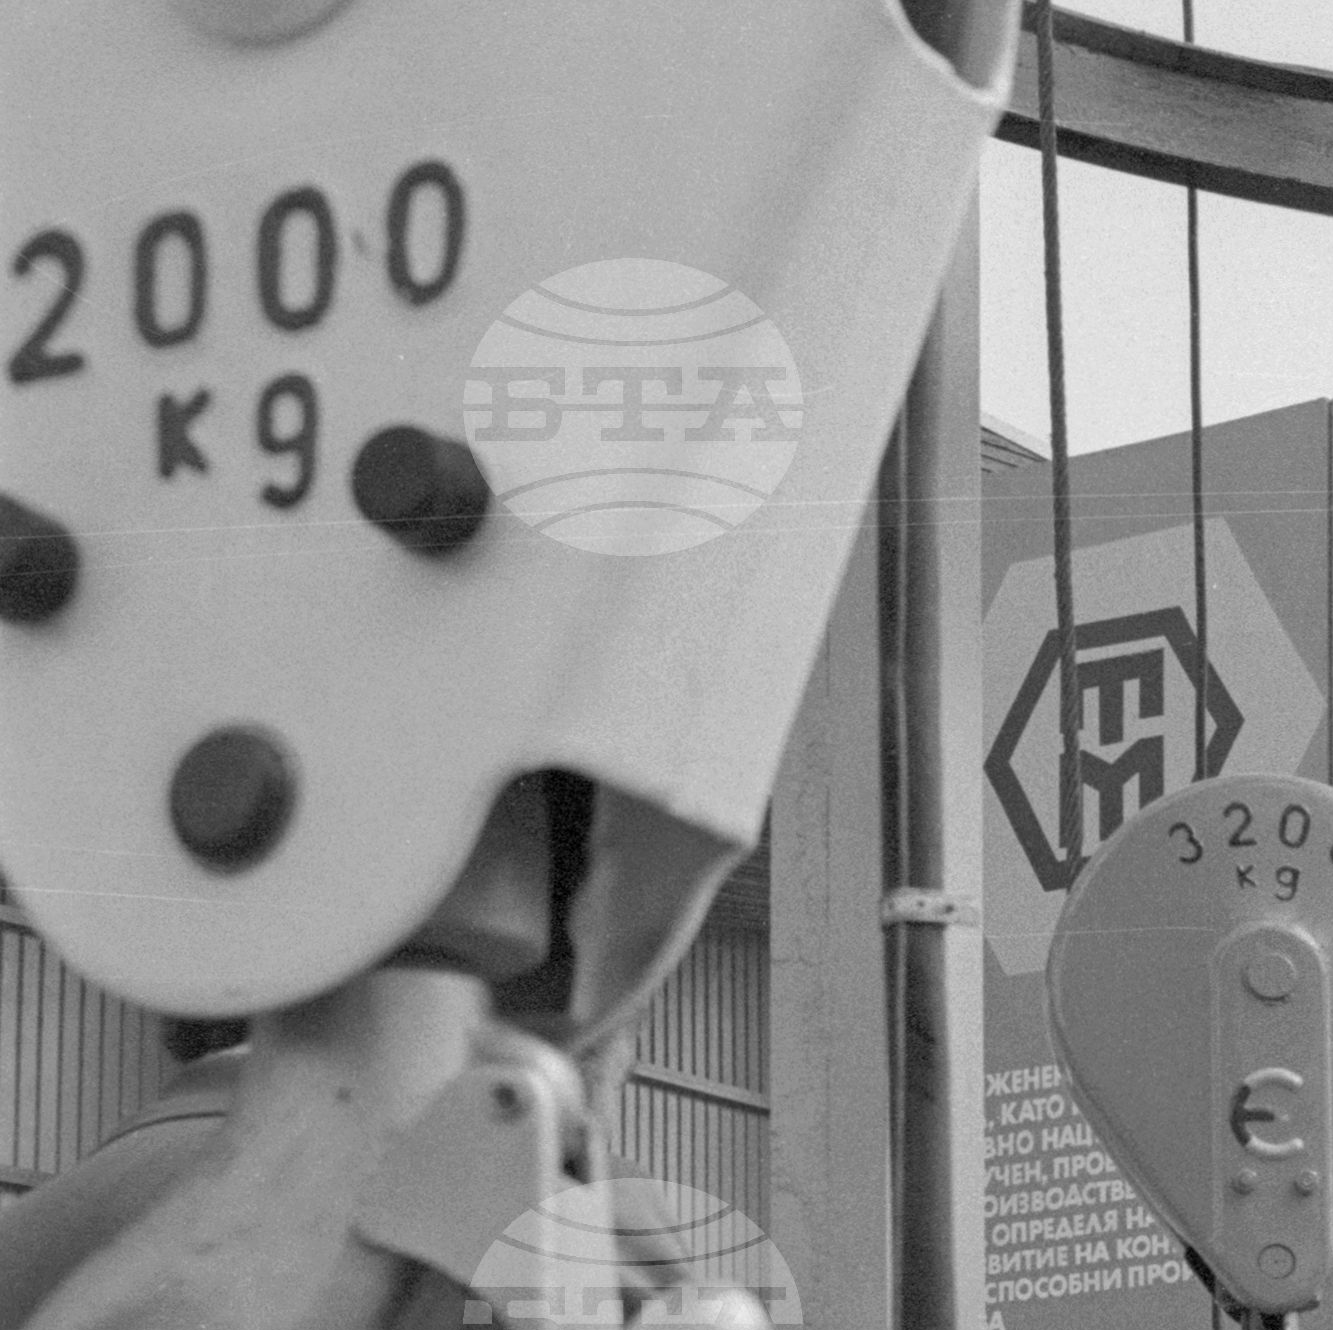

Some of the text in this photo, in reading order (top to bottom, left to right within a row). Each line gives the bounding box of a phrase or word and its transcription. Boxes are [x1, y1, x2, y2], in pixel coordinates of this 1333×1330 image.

[7, 158, 468, 385] 2000
[156, 371, 321, 510] kg
[1235, 864, 1300, 901] kg
[1000, 1094, 1064, 1126] КАТО
[991, 1209, 1117, 1247] ОПРЕДЕЛЯ
[1073, 1240, 1110, 1265] НА
